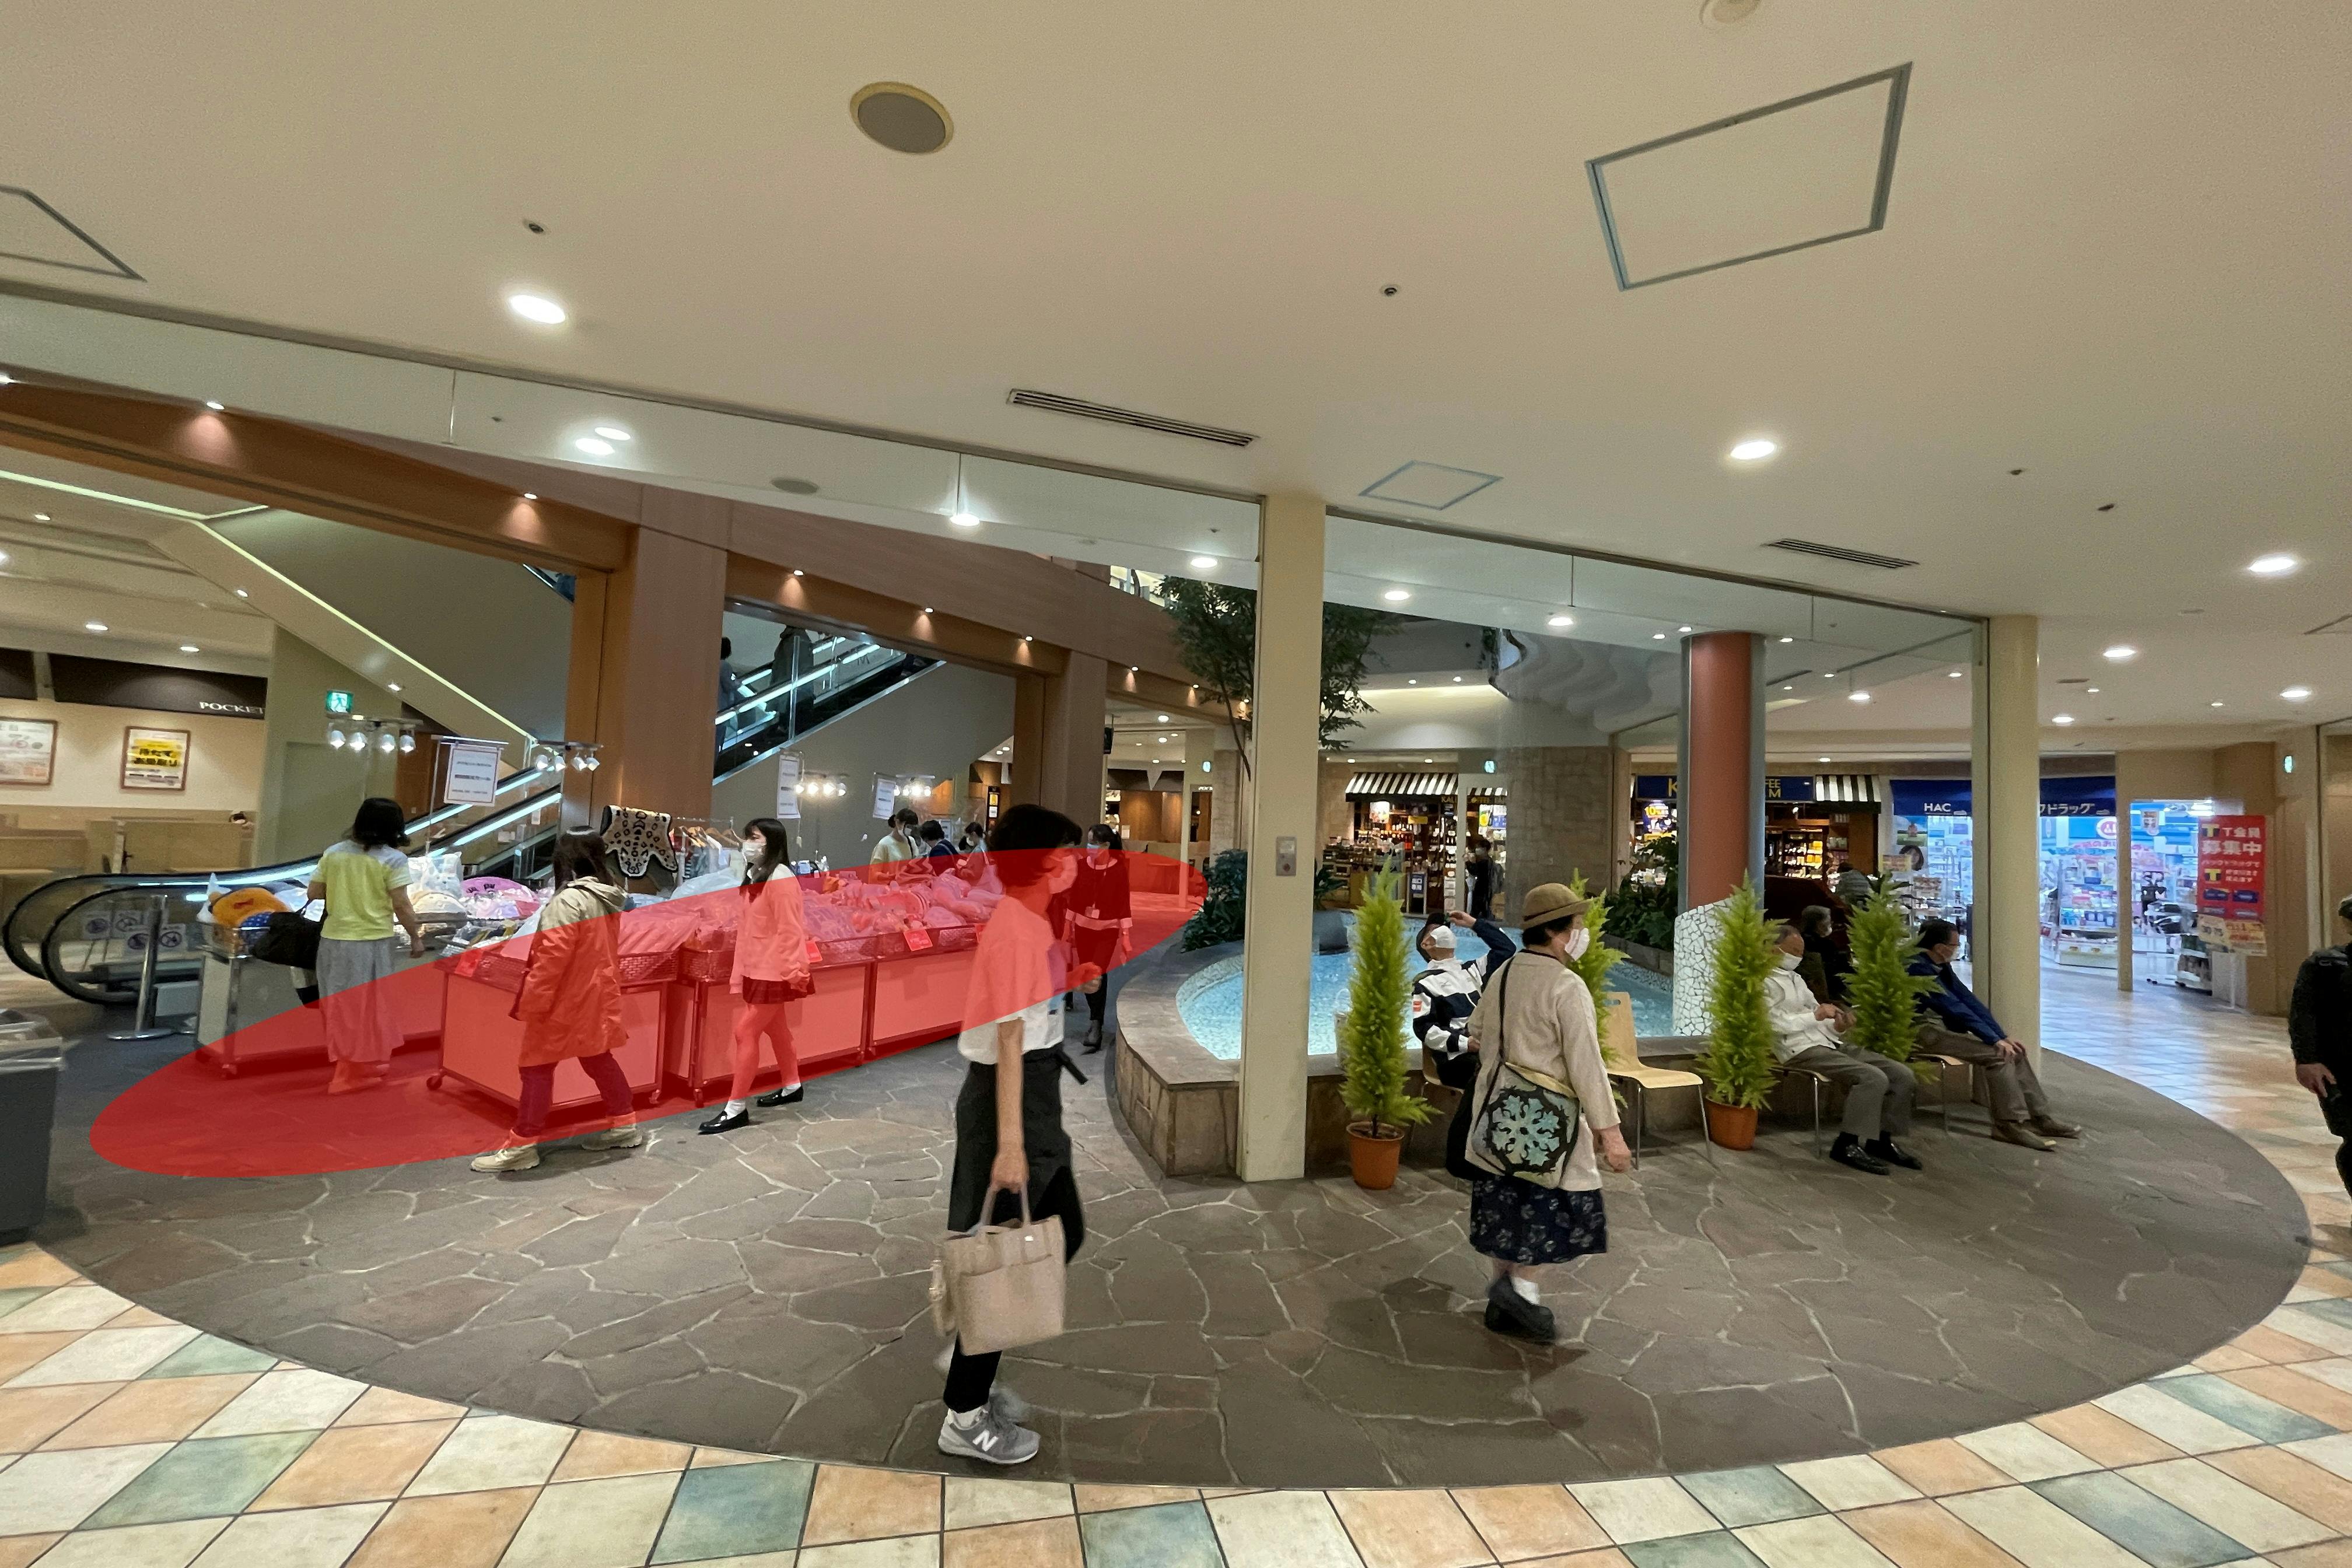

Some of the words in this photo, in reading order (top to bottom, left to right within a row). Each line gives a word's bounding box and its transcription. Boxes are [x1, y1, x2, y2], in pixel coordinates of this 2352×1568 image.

[199, 701, 264, 714] POCKET
[1924, 803, 1951, 812] HAC
[2202, 840, 2262, 856] 募集中
[972, 1429, 999, 1452] N
